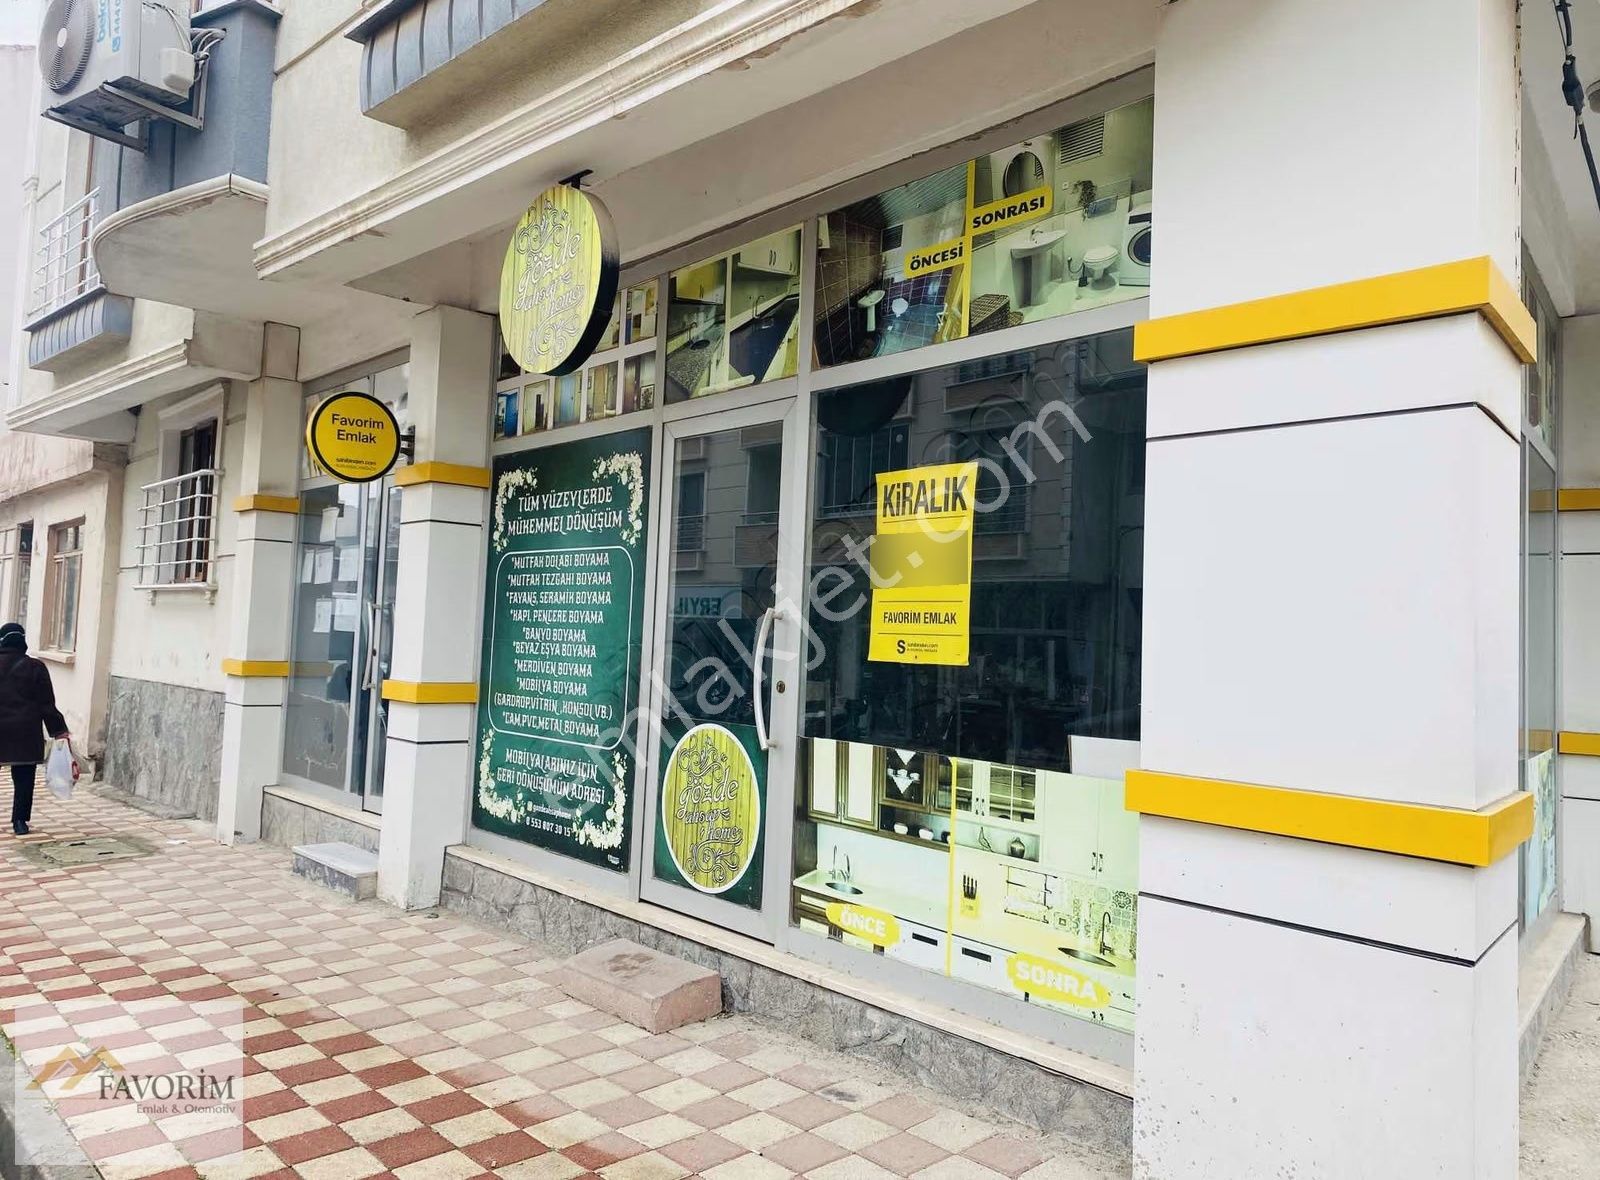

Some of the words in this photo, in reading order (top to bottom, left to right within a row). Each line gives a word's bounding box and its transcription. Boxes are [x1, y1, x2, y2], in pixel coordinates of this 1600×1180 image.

[972, 195, 1045, 229] SONRASI
[909, 242, 964, 271] ÖNCESİ
[331, 413, 384, 430] Favorim
[337, 429, 377, 444] Emlak
[519, 493, 540, 512] TÜM
[542, 486, 613, 510] YÜZEYLERDE
[508, 516, 568, 536] MÜKEMMEL
[566, 508, 622, 534] DÖNÜŞÜM
[545, 555, 573, 570] DOLABI
[574, 552, 610, 567] BOYAMA
[541, 572, 574, 587] TEZGAHI
[575, 571, 612, 586] BOYAMA
[539, 588, 574, 605] SERAMİK
[575, 591, 612, 605] BOYAMA
[532, 609, 568, 625] PENCERE
[568, 610, 604, 624] BOYAMA
[883, 609, 922, 625] FAVORİM
[922, 611, 957, 625] EMLAK
[552, 628, 587, 642] BOYAMA
[541, 643, 561, 659] EŞYA
[561, 643, 597, 658] BOYAMA
[896, 639, 906, 654] S
[559, 662, 593, 677] BOYAMA
[552, 681, 588, 697] BOYAMA
[564, 722, 600, 738] BOYAMA
[505, 748, 576, 778] MOBİLYALARINIZ
[577, 758, 601, 784] İÇİN
[497, 766, 515, 784] GERİ
[516, 770, 574, 801] DÖNÜŞÜMÜN
[571, 783, 606, 805] ADRESİ
[677, 765, 739, 821] gözde
[531, 817, 542, 830] 553
[554, 824, 563, 835] 30
[563, 827, 572, 837] 15
[706, 826, 742, 842] home
[839, 905, 887, 938] ÖNCE
[1015, 961, 1099, 1002] SONRA
